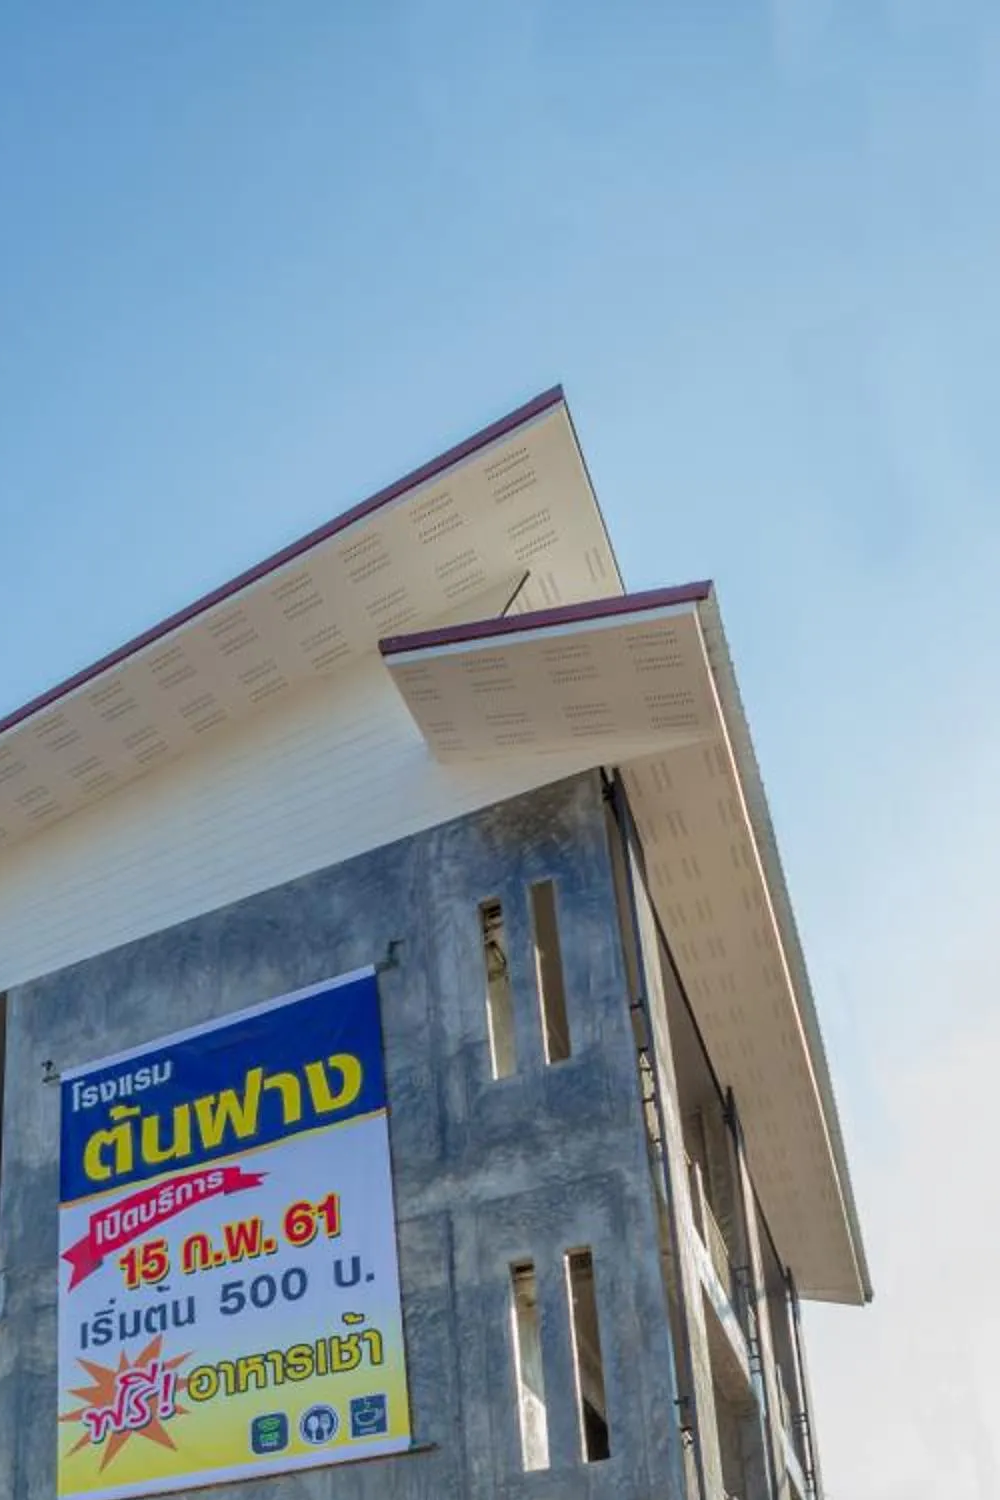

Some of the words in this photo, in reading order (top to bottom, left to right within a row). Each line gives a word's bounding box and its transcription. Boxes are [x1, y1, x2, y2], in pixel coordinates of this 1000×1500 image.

[72, 1060, 173, 1112] โรงแรม
[83, 1053, 363, 1181] ต้นฝาง
[95, 1170, 225, 1245] เปิดบริการ
[119, 1237, 170, 1289] 15
[182, 1216, 277, 1274] ก.พ.
[283, 1192, 342, 1247] 61
[80, 1285, 196, 1349] เริ่มต้น
[219, 1267, 308, 1316] 500
[334, 1256, 375, 1289] บ.
[83, 1361, 178, 1443] ฟรี!
[188, 1312, 385, 1402] อาหารเช้า
